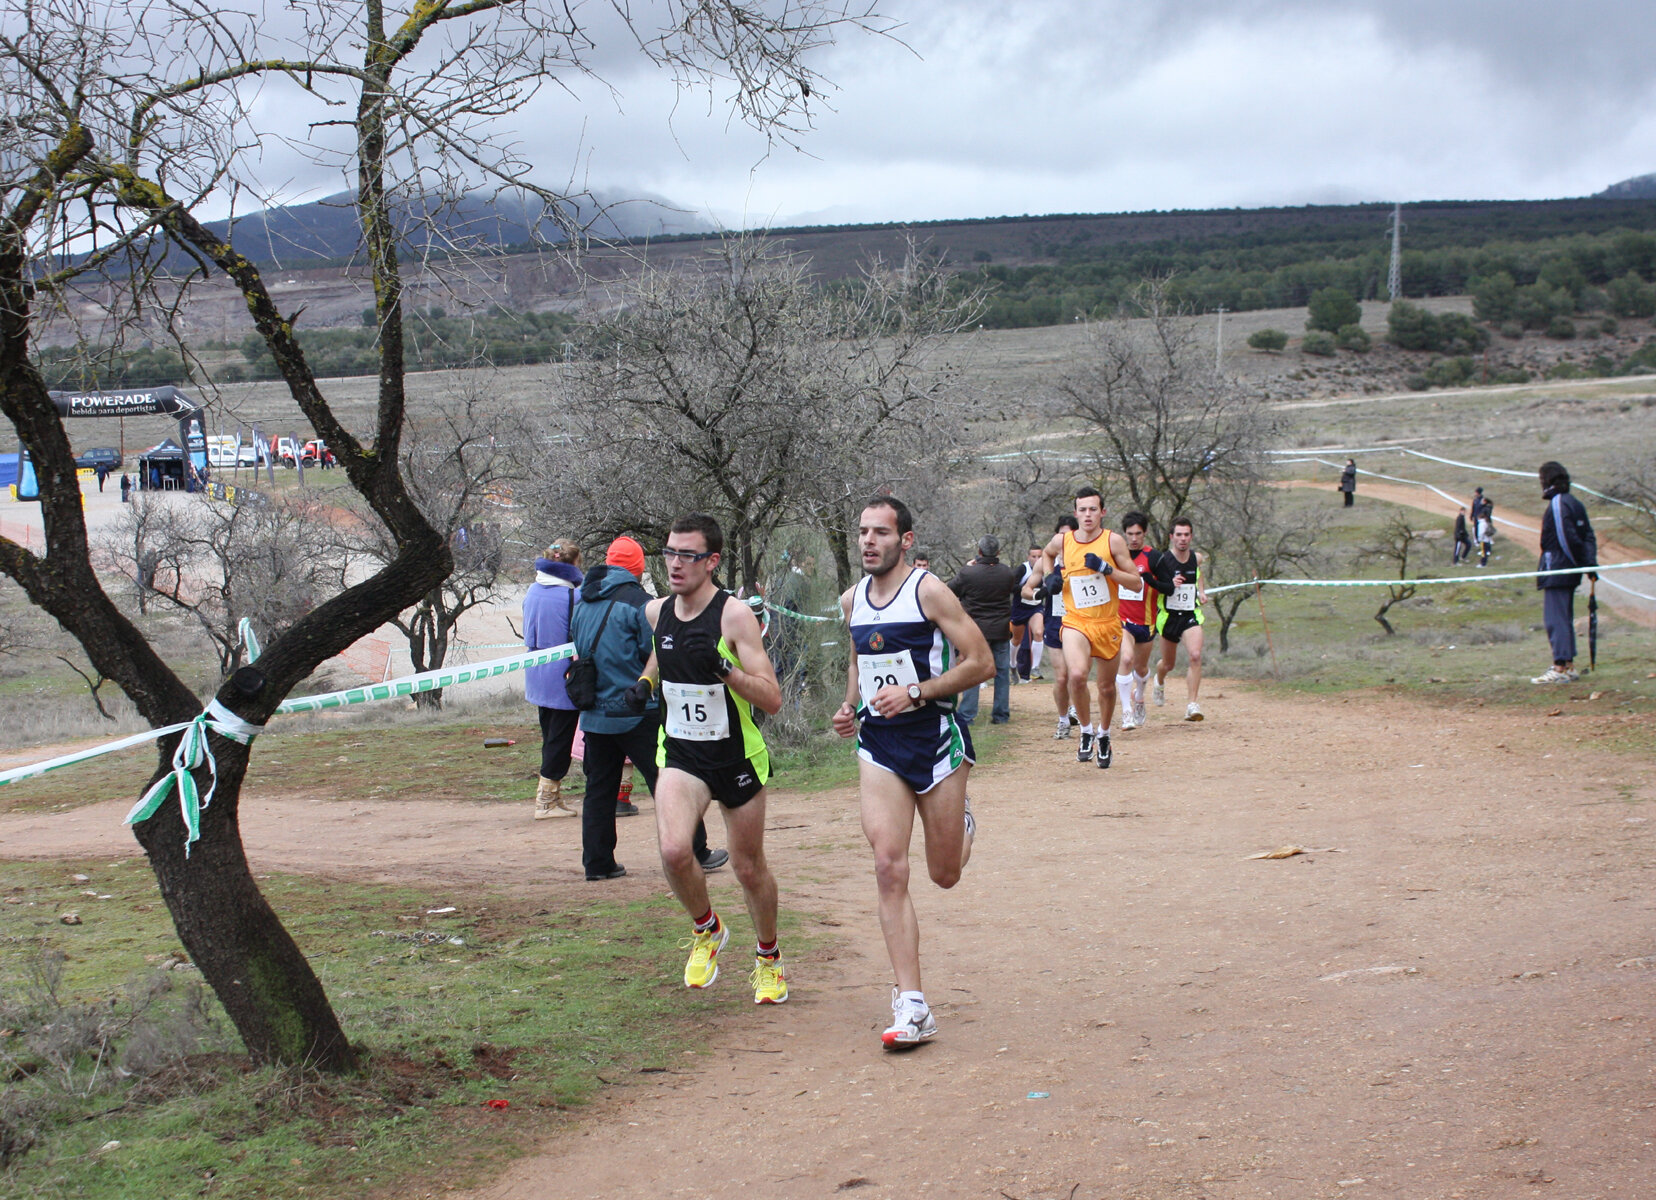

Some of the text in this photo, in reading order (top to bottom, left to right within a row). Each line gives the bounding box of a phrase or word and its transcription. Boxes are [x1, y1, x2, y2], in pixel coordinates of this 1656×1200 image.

[71, 404, 157, 415] bebida para deportistas
[1082, 585, 1098, 597] 13
[1177, 593, 1189, 602] 19
[681, 702, 708, 722] 15
